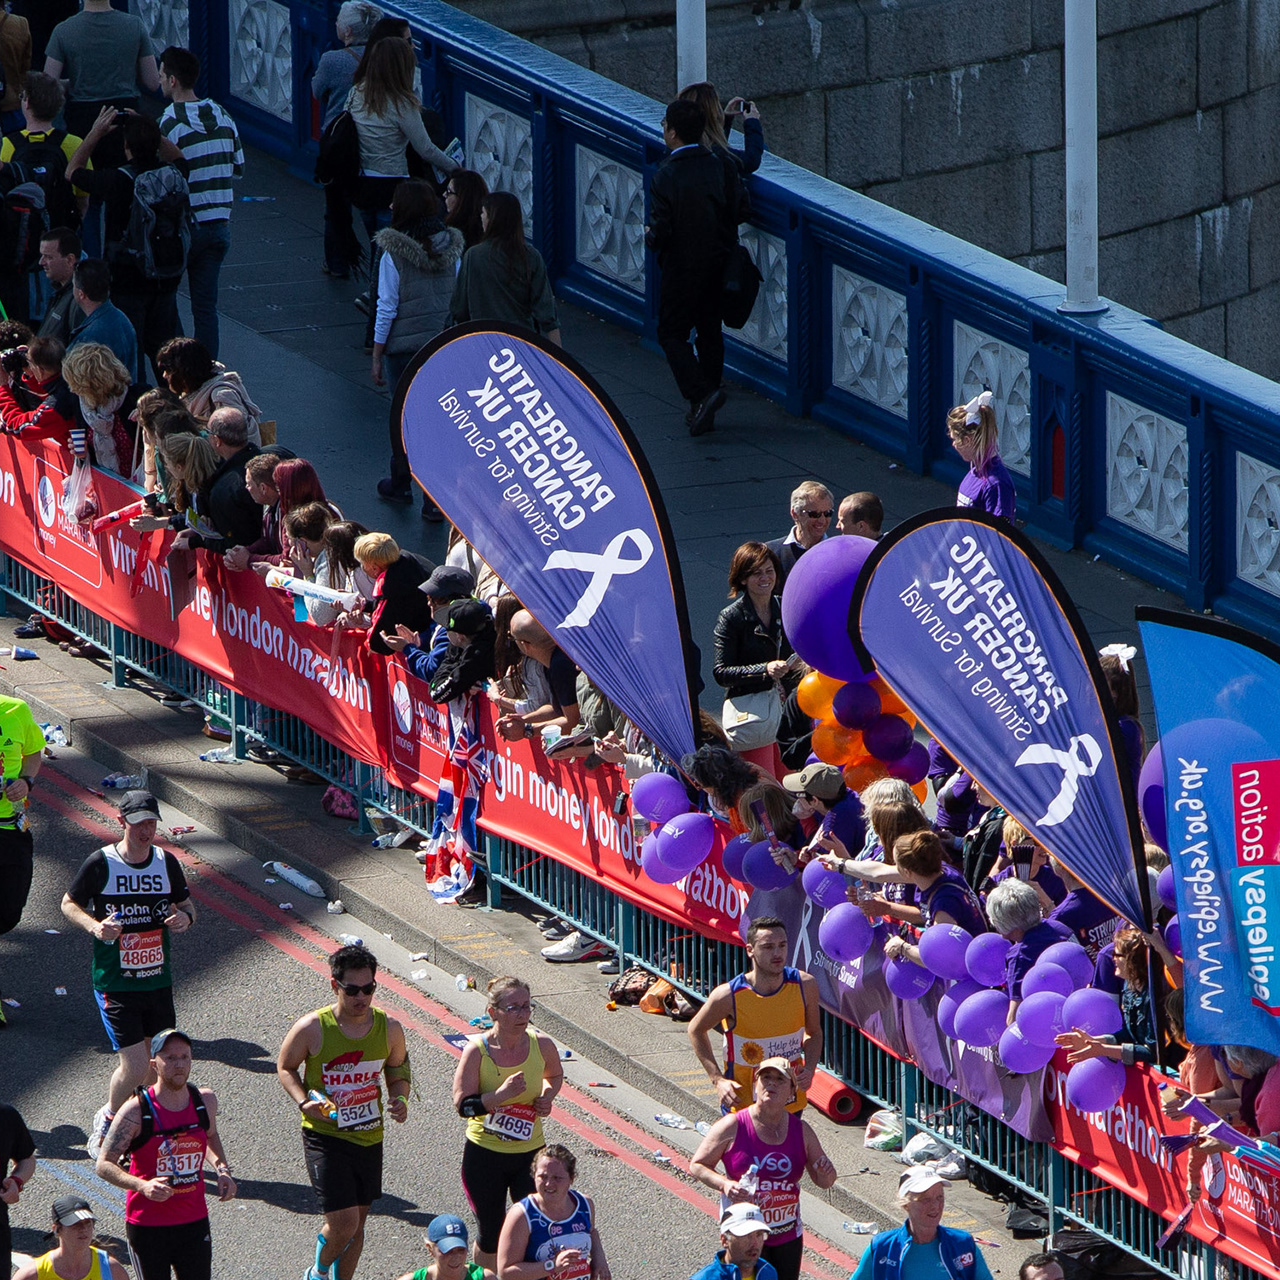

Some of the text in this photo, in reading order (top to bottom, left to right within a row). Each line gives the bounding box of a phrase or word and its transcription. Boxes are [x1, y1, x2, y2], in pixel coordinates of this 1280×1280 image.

[38, 528, 57, 550] money
[222, 597, 284, 661] london
[287, 635, 373, 712] marathon
[414, 698, 447, 731] LONDON
[395, 735, 415, 756] money
[528, 770, 591, 846] money
[116, 874, 163, 894] RUSS
[120, 902, 150, 916] John
[141, 935, 161, 945] money
[121, 949, 163, 967] 48665
[135, 966, 162, 979] #boost
[767, 1037, 801, 1054] Help the
[356, 1089, 378, 1101] money
[341, 1103, 375, 1122] 5521
[489, 1114, 533, 1138] 14695
[178, 1139, 203, 1151] money
[157, 1154, 202, 1175] 53512
[172, 1174, 199, 1187] #boost
[1226, 1160, 1269, 1200] LONDON
